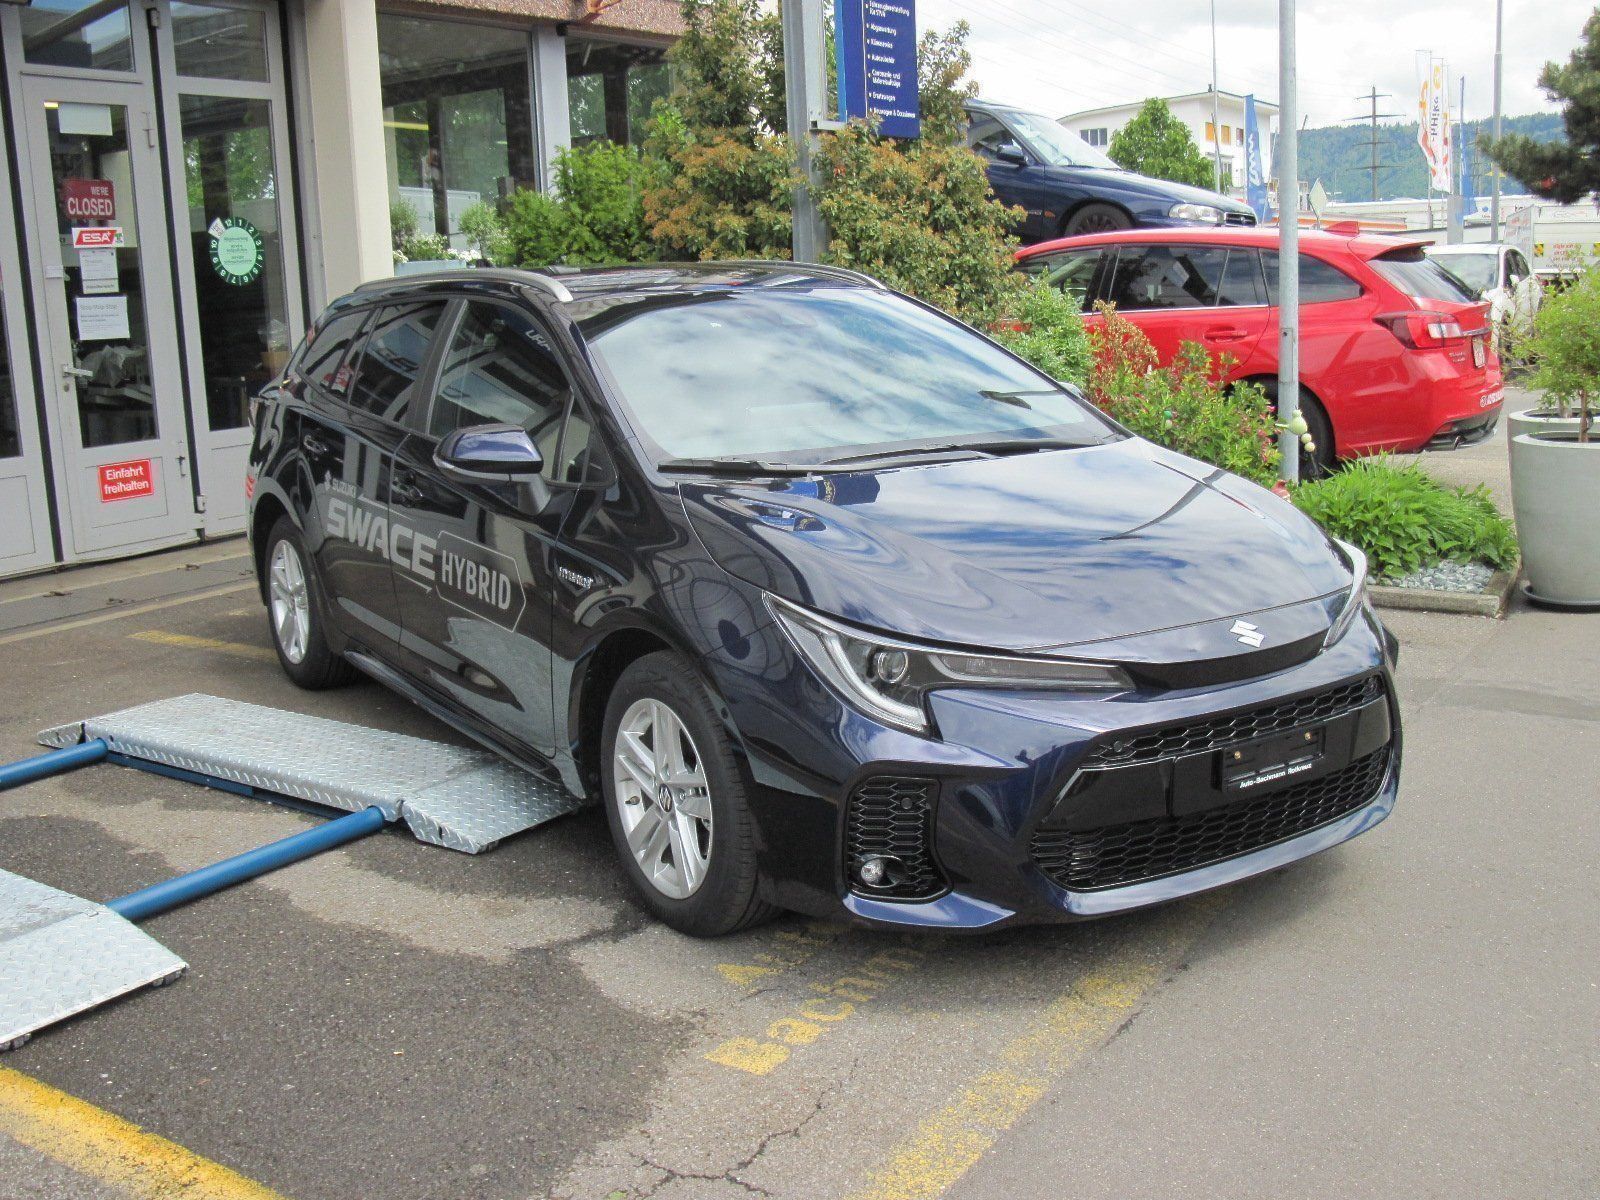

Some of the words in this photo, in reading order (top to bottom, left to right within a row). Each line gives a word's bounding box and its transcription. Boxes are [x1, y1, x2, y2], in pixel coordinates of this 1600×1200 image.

[67, 197, 113, 216] CLOSED
[105, 466, 145, 481] Einfahrt
[103, 480, 150, 495] freihalten
[327, 497, 438, 581] SWACE
[441, 549, 512, 611] HYBRID
